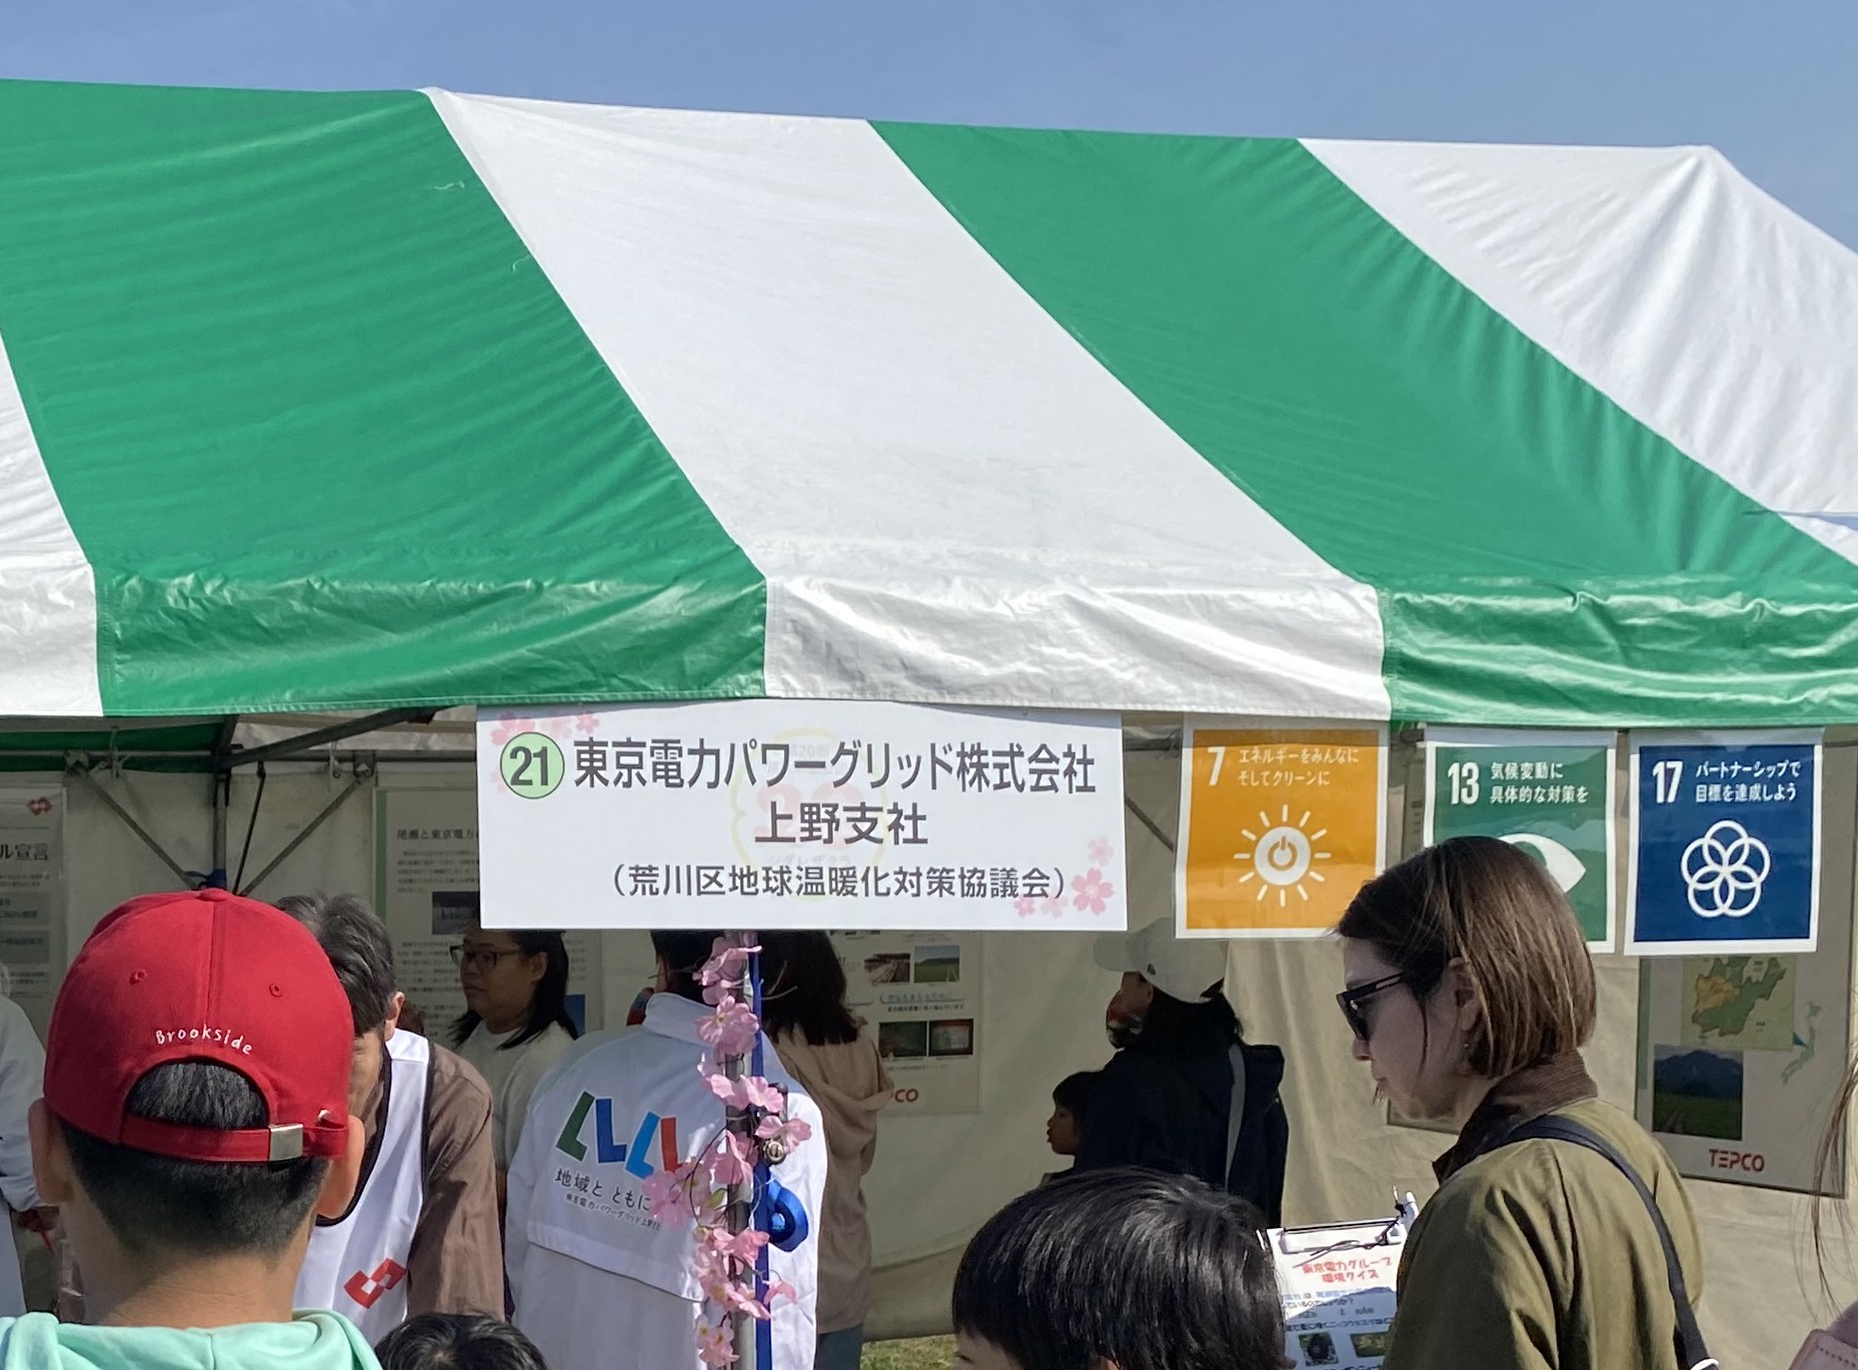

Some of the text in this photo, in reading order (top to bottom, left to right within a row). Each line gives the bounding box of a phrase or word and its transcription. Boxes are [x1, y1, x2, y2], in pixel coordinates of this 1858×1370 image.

[509, 736, 1096, 794] 21 東京電力パワーグリッド株式会社
[1207, 746, 1226, 786] 7
[1239, 748, 1359, 764] エネルギーをみんなに
[1491, 761, 1564, 780] 気候変動に
[1695, 760, 1801, 779] パートナーシップで
[1238, 770, 1330, 786] そしてクリーンに
[1447, 761, 1481, 805] 13
[1652, 761, 1683, 803] 17
[1695, 782, 1797, 803] 目標を達成しよう
[1490, 784, 1589, 804] 具体的な対策を
[754, 801, 928, 846] 上野支社
[611, 862, 1066, 899] （荒川区地球温暖化対策協議会）
[155, 1024, 253, 1055] Brookside
[1708, 1148, 1765, 1172] TEPCO
[555, 1168, 603, 1197] 地域と
